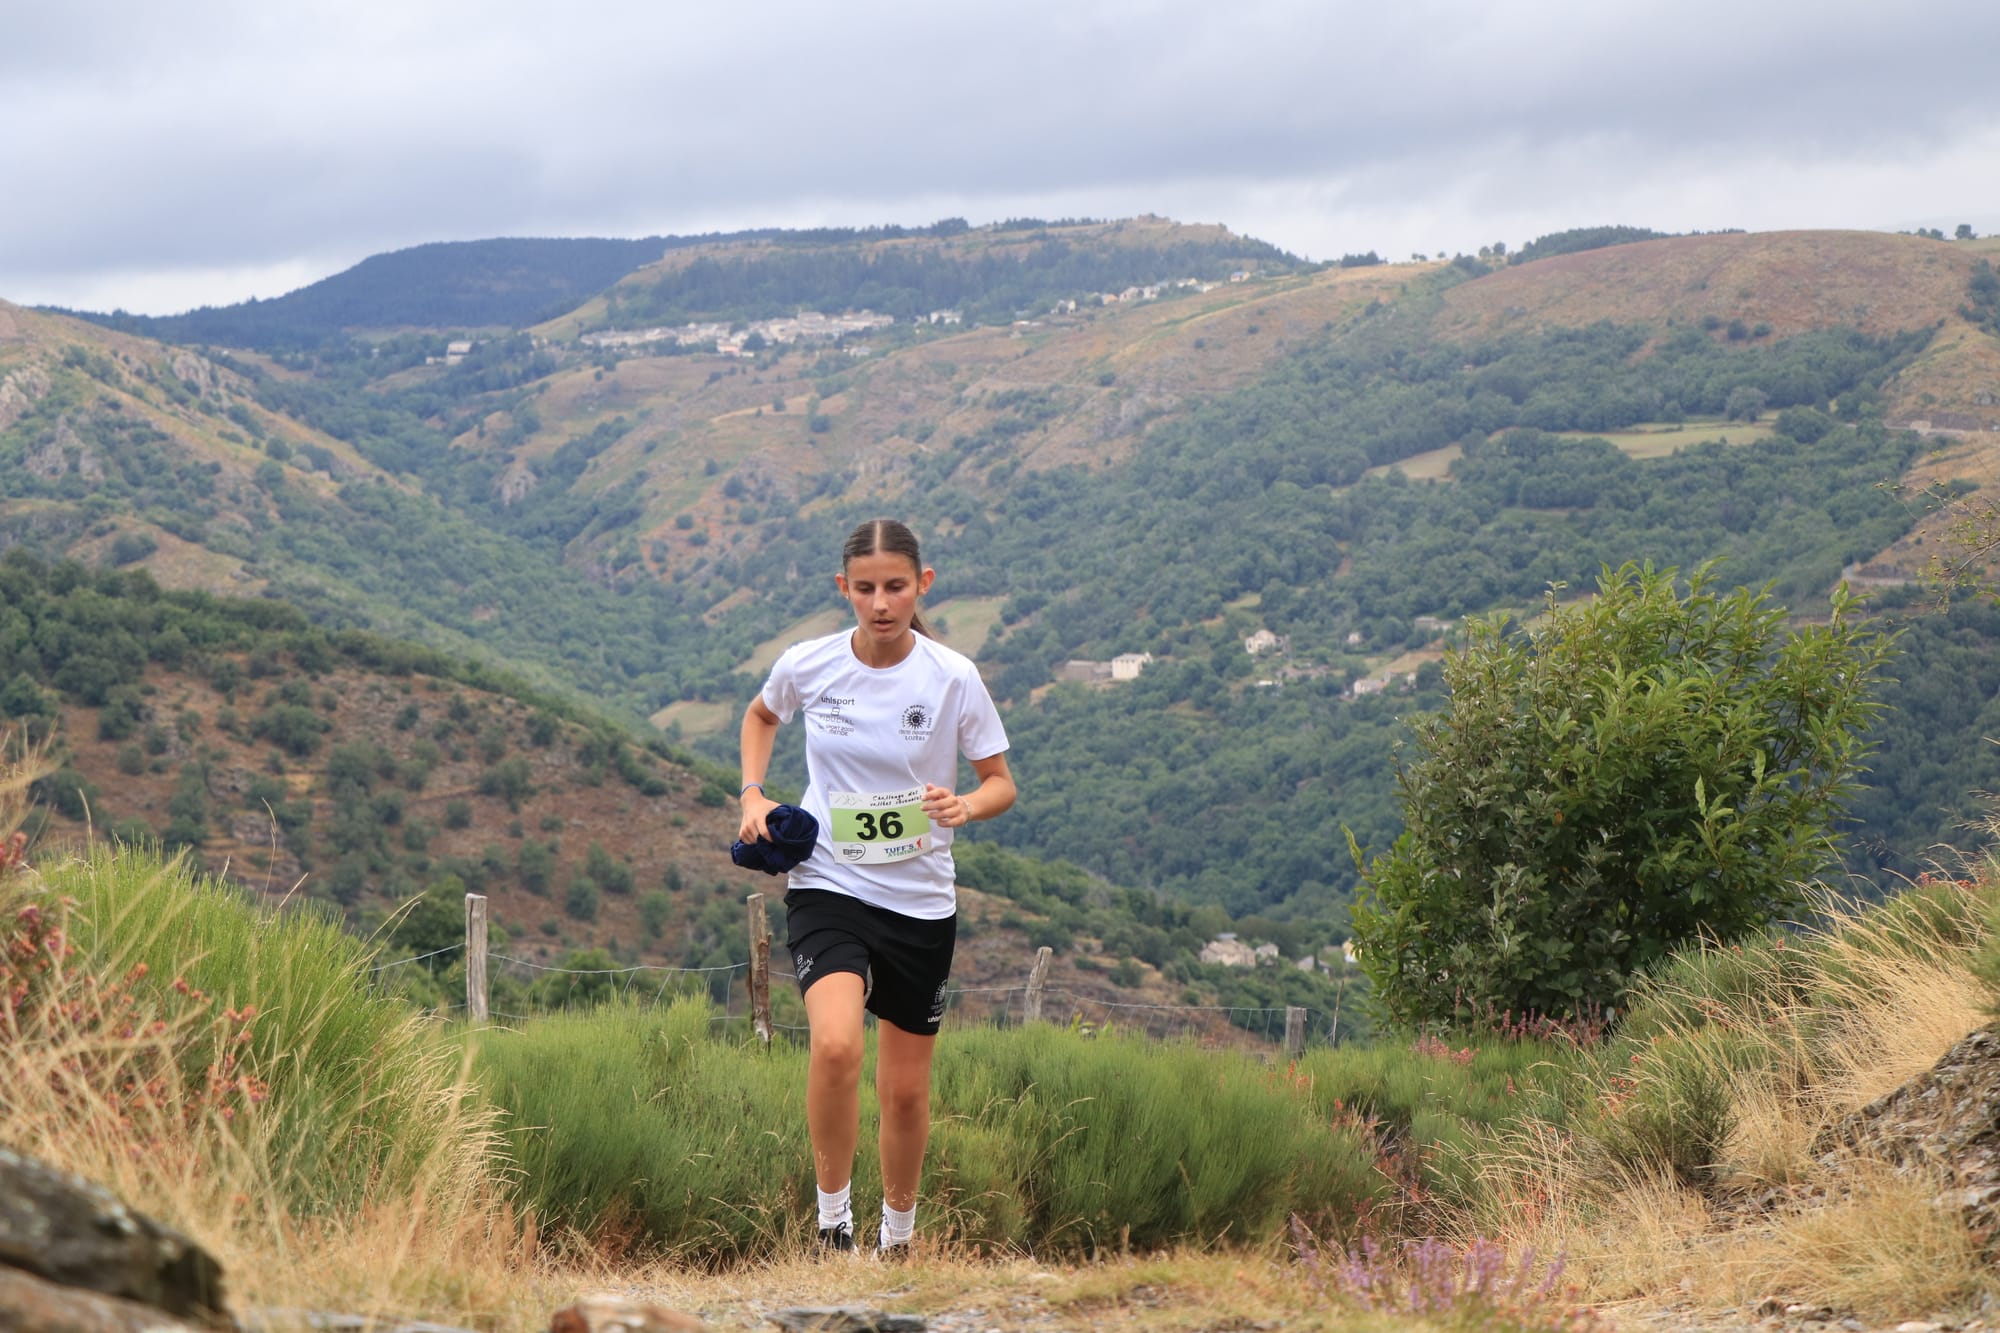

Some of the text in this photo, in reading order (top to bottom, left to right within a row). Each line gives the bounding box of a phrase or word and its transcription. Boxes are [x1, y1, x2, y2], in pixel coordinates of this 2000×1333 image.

[821, 695, 855, 706] uhlsport
[872, 793, 904, 802] Challenge
[855, 811, 904, 841] 36
[884, 843, 914, 854] TUFF'S
